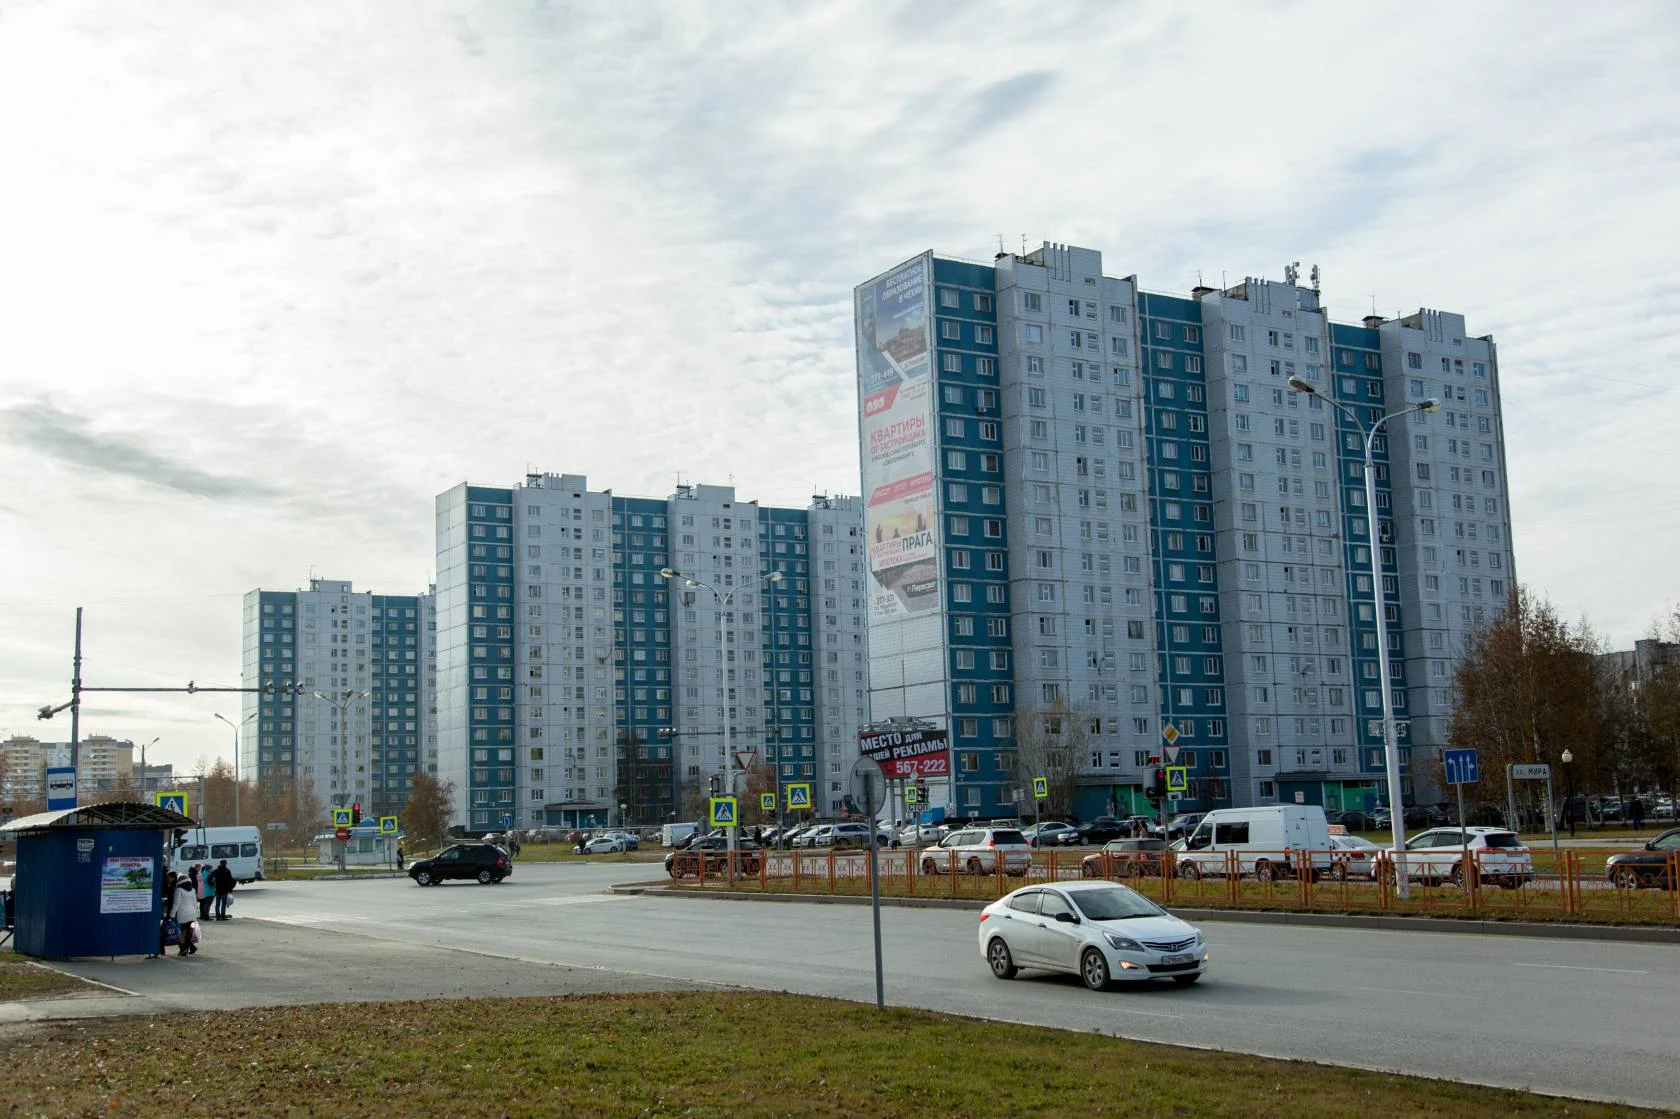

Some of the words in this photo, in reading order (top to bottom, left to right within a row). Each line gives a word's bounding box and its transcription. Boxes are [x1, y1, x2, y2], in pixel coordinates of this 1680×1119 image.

[882, 275, 923, 300] ОБРАЗОВАНИЕ
[870, 415, 925, 444] КВАРТИРЫ
[880, 429, 926, 452] ЗАСТРОЙЩИКА
[902, 532, 932, 552] ПРАГА
[912, 582, 936, 592] Пересвет
[861, 732, 902, 751] МЕСТО
[905, 732, 923, 744] ДЛЯ
[893, 738, 948, 758] РЕКЛАМЫ
[896, 759, 947, 774] 567-222
[1528, 767, 1547, 776] МИРА
[908, 804, 928, 812] СТОП
